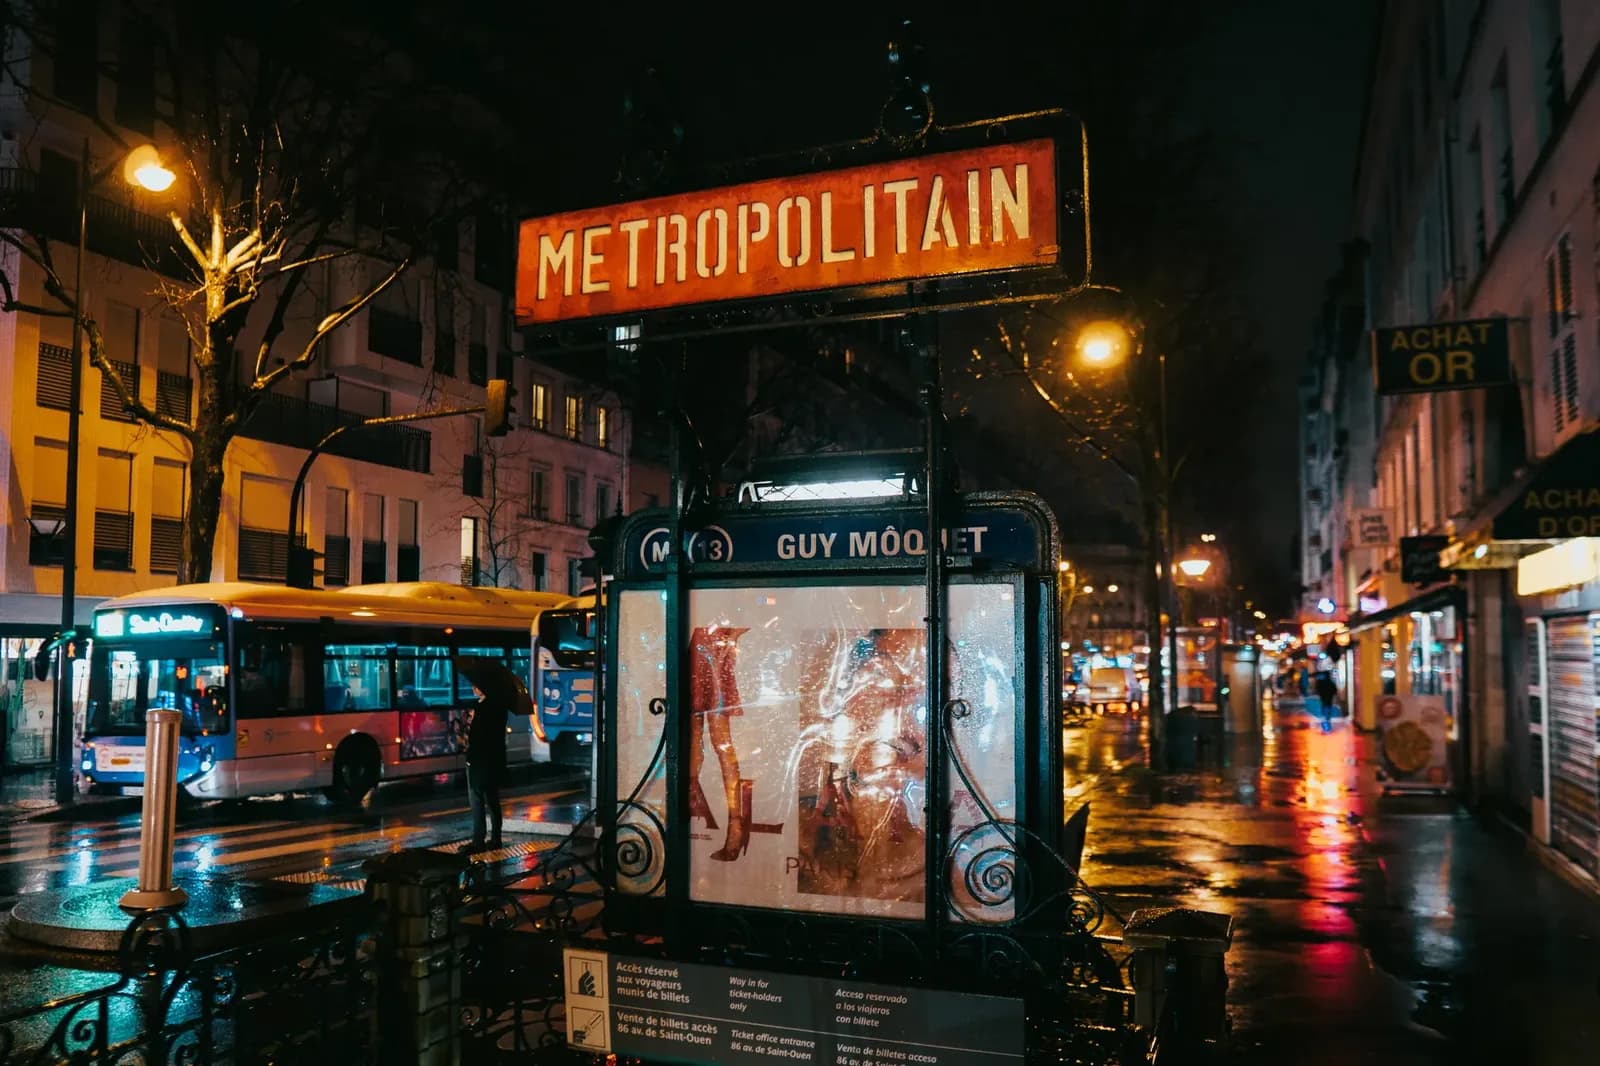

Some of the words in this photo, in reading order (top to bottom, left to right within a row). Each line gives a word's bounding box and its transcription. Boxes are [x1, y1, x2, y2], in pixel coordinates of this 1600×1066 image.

[536, 163, 1030, 300] METROPOLITAIN
[1391, 323, 1491, 352] ACHAT
[1409, 350, 1475, 385] OR
[1524, 488, 1600, 510] ACHA
[777, 532, 837, 560] GUY
[849, 525, 988, 558] MÔQET
[616, 962, 642, 974] Accès
[644, 966, 679, 978] réservé
[616, 975, 633, 985] aux
[635, 977, 682, 991] voyageurs
[729, 976, 746, 988] Way
[747, 978, 756, 987] in
[757, 979, 769, 989] for
[617, 987, 644, 998] munis
[646, 989, 659, 1000] de
[660, 990, 690, 1004] billets
[729, 989, 782, 1003] ticket-holders
[835, 988, 864, 999] Acceso
[865, 993, 908, 1004] reservado
[729, 1002, 747, 1012] only
[843, 1002, 855, 1011] los
[857, 1004, 890, 1016] viajeros
[617, 1011, 644, 1024] Vente
[646, 1015, 658, 1026] de
[660, 1017, 689, 1030] billets
[691, 1023, 718, 1034] accès
[835, 1015, 851, 1024] con
[853, 1016, 880, 1027] billete
[617, 1023, 629, 1033] 86
[631, 1027, 644, 1036] av.
[645, 1027, 657, 1038] de
[659, 1029, 712, 1045] Saint-Ouen
[731, 1029, 754, 1040] Ticket
[756, 1032, 778, 1043] office
[779, 1037, 815, 1049] entrance
[731, 1041, 741, 1050] 86
[742, 1044, 754, 1052] av.
[755, 1045, 766, 1054] de
[767, 1046, 811, 1060] Saint-Ouen
[863, 1047, 874, 1056] de
[875, 1049, 906, 1060] billetes
[908, 1055, 937, 1064] acceso
[836, 1055, 848, 1065] 86
